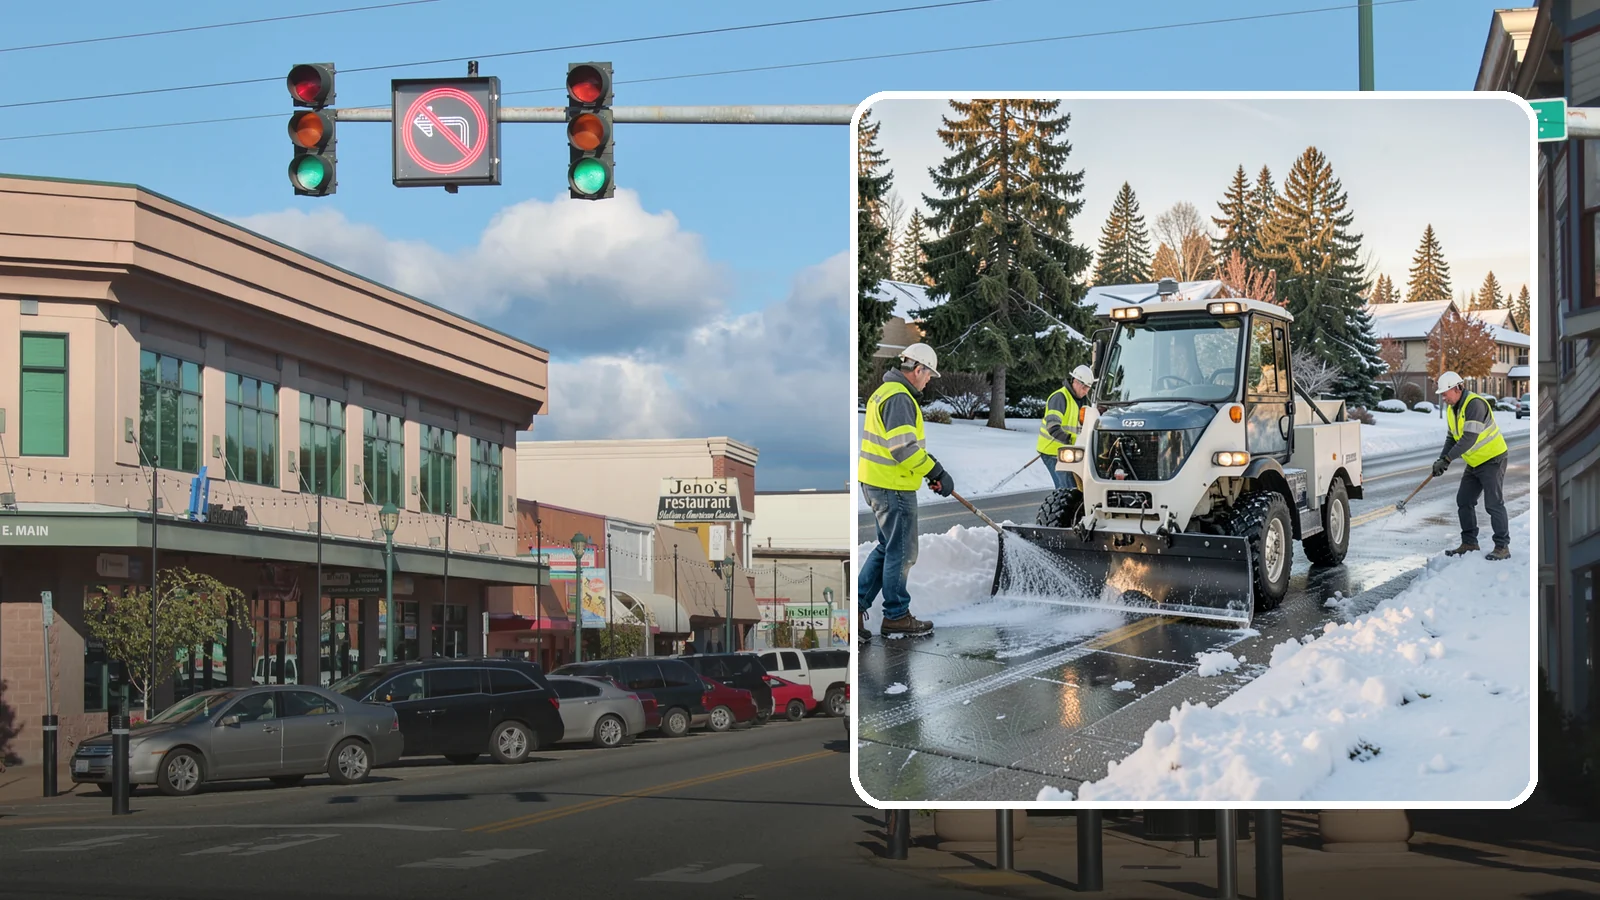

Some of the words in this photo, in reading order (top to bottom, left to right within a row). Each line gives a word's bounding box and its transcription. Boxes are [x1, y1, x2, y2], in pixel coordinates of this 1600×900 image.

[670, 480, 727, 494] Jeno's
[665, 496, 730, 508] restaurant
[2, 526, 12, 536] E.
[15, 526, 49, 536] MAIN
[797, 608, 828, 616] Street
